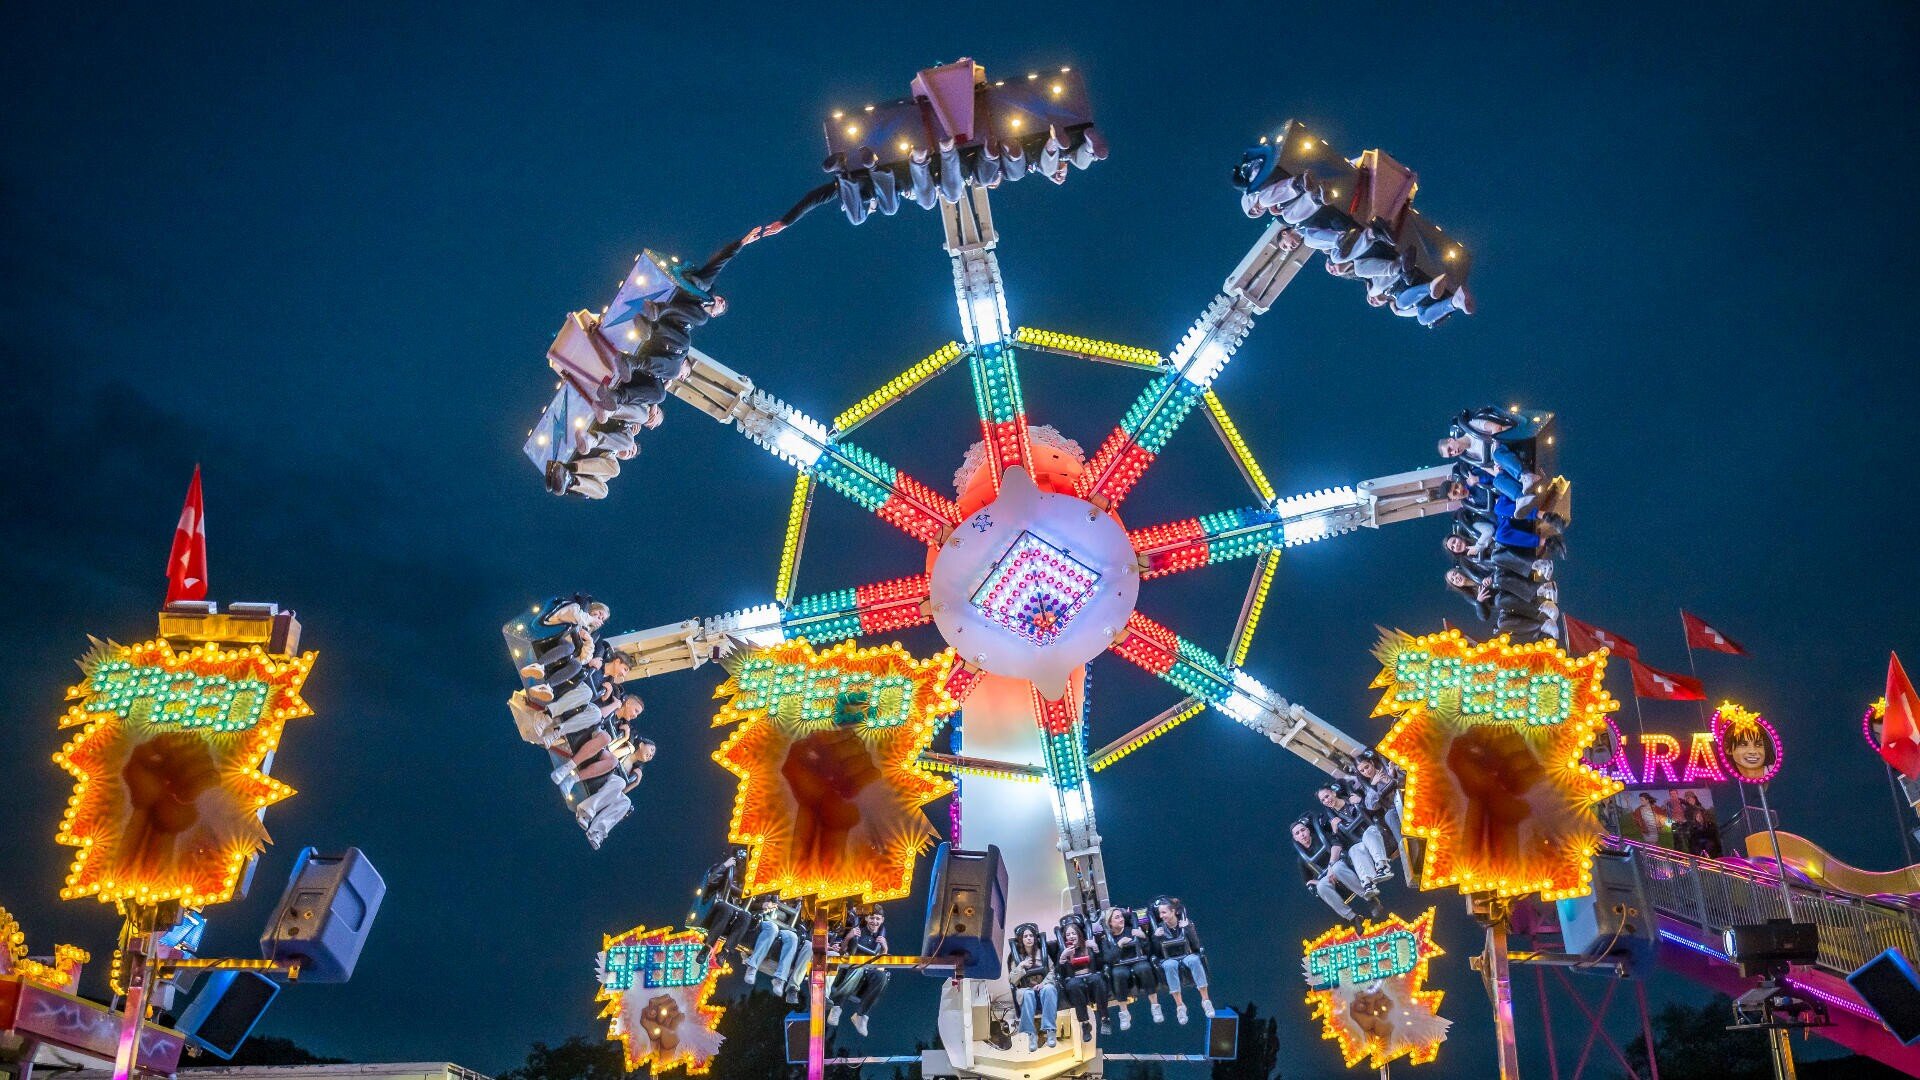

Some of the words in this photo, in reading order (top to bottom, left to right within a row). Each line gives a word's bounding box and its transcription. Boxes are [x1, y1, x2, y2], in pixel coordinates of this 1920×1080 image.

[85, 661, 269, 731] SPEED
[735, 658, 913, 728] SPEED
[1395, 651, 1571, 726] SPEED
[604, 944, 709, 989] SPEED
[1311, 930, 1418, 990] SPEED
